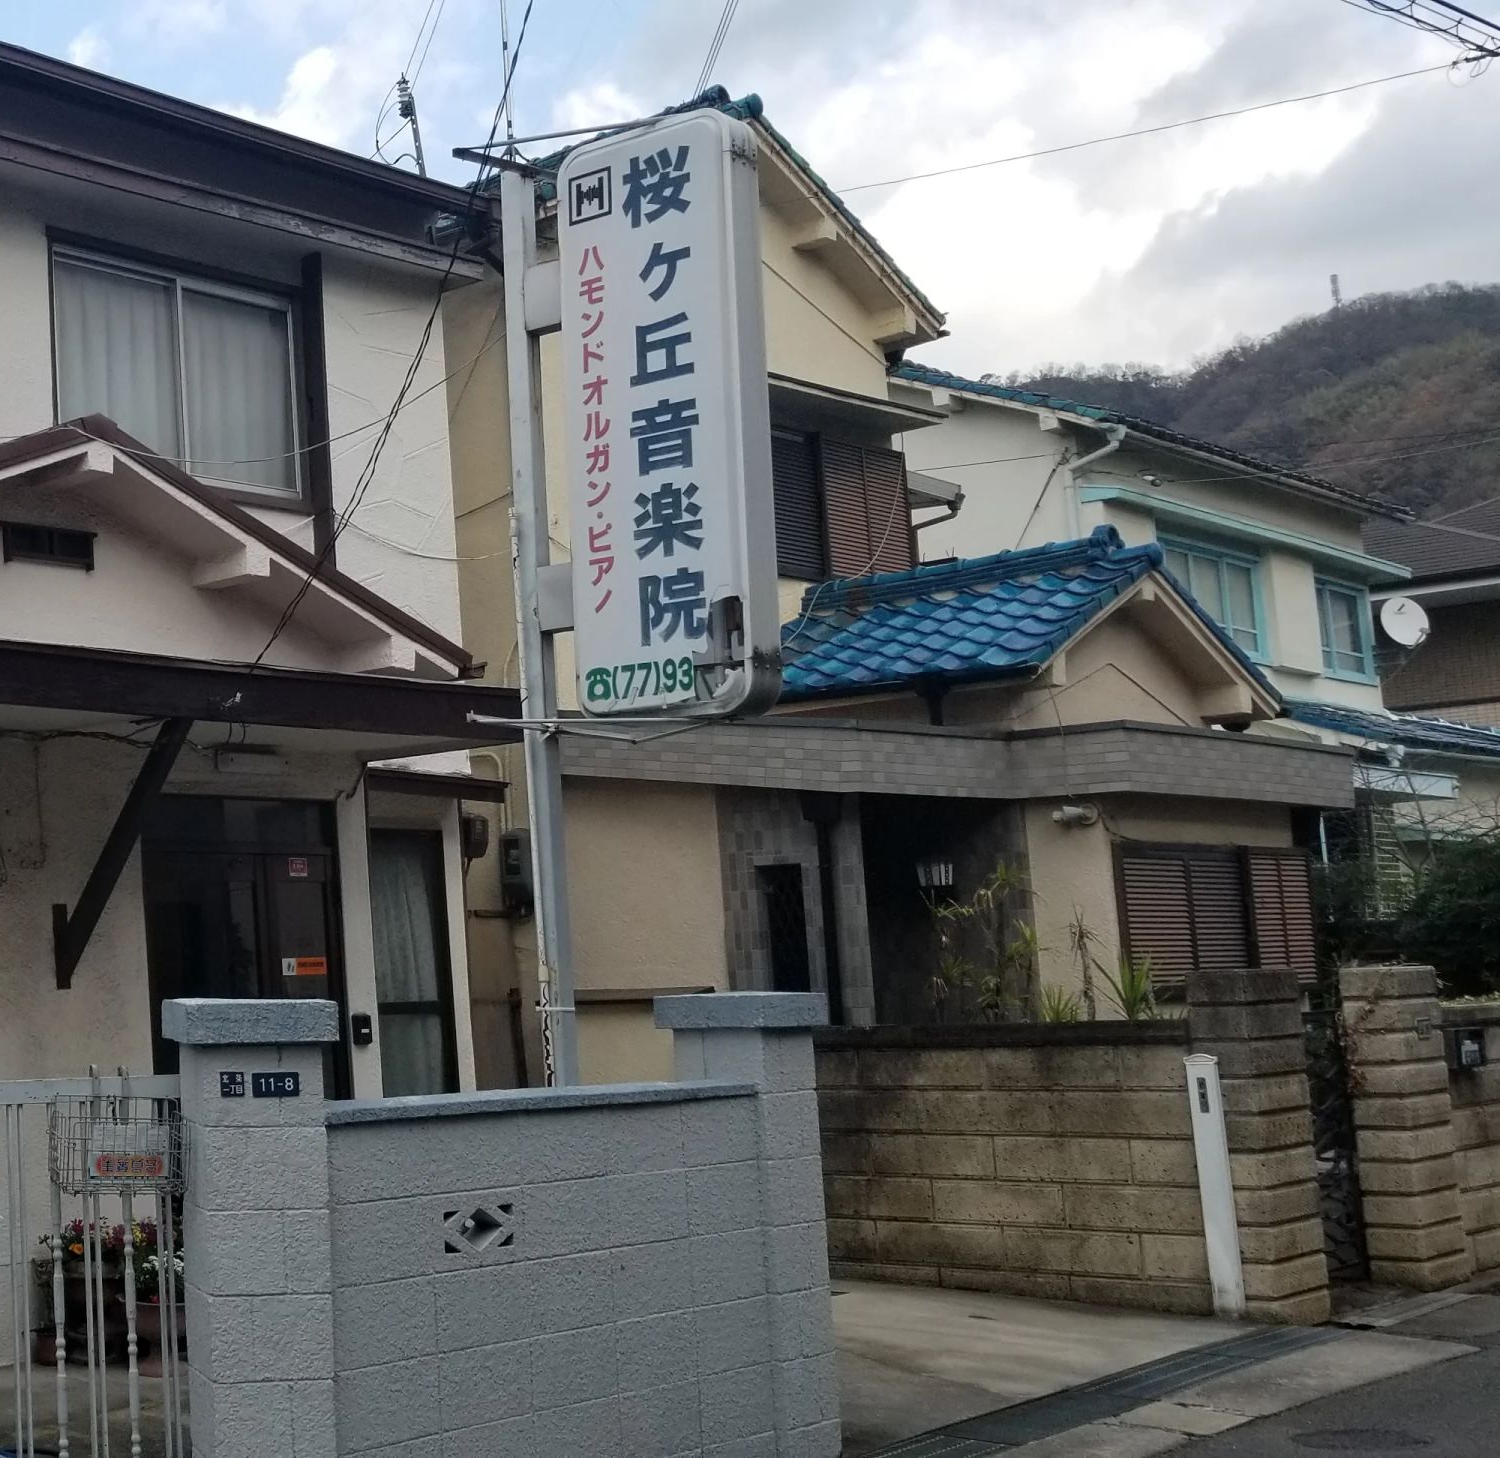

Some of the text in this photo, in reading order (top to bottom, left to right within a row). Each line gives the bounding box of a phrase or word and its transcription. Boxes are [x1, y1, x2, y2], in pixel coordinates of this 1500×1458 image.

[576, 245, 614, 614] ハモンドオルガン・ピアノ
[222, 1084, 243, 1095] 一丁目
[259, 1076, 294, 1092] 11-8
